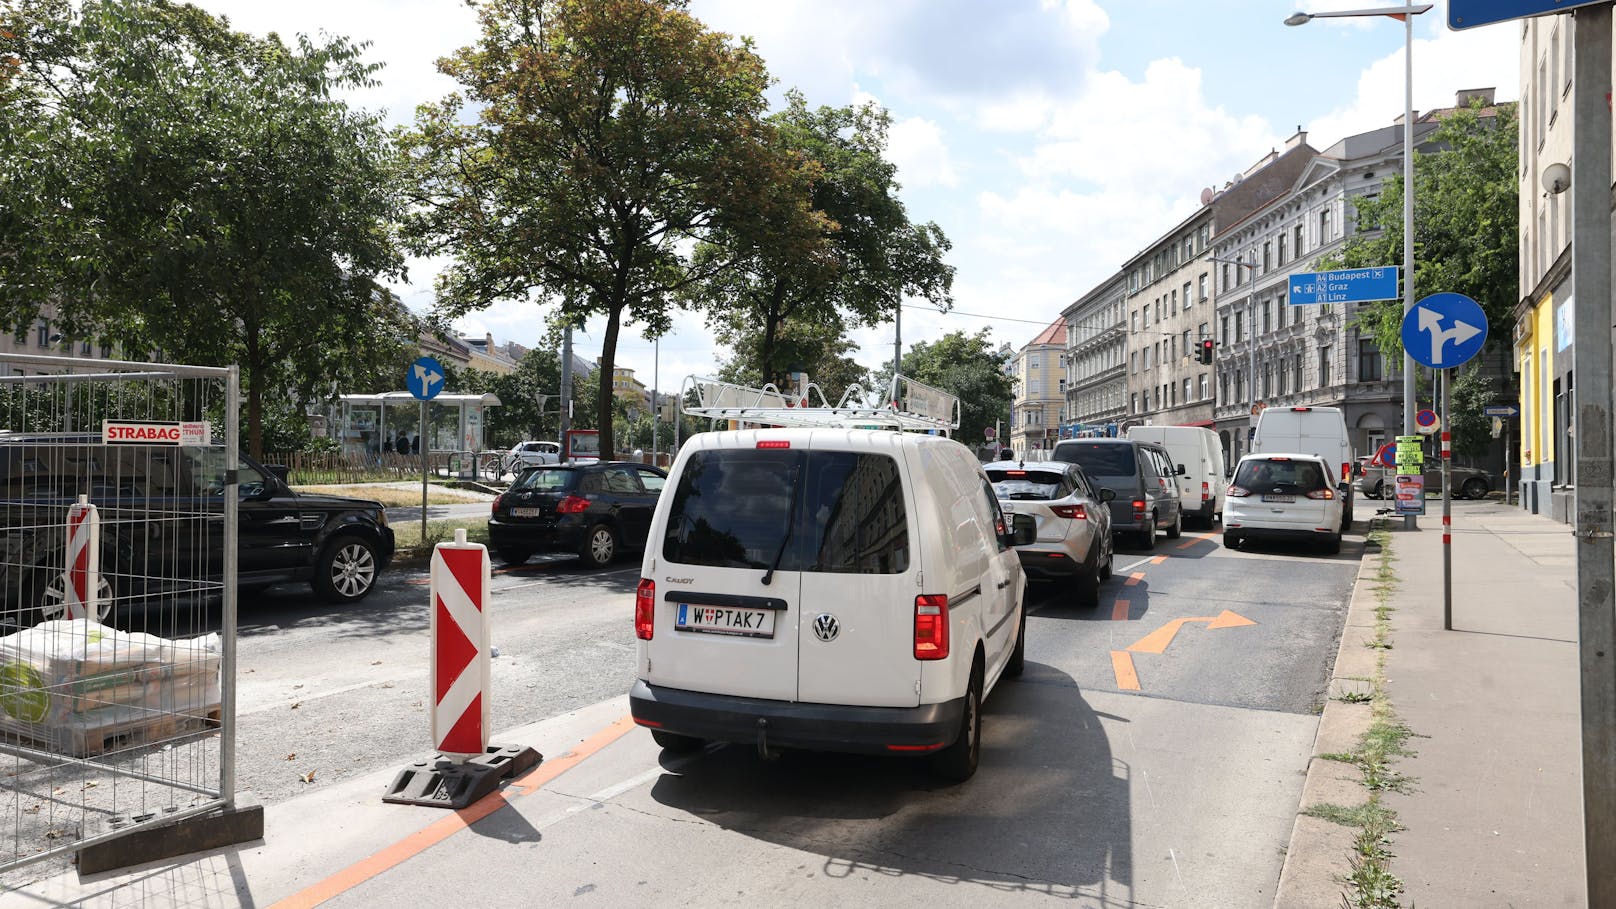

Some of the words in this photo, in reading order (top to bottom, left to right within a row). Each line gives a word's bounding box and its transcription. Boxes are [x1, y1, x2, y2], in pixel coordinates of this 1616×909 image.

[1317, 274, 1327, 282] A4
[1328, 271, 1370, 281] Budapest
[1317, 284, 1326, 292] A2
[1329, 283, 1348, 291] Graz
[1317, 294, 1326, 302] A1
[1328, 293, 1347, 301] Linz
[108, 427, 180, 440] STRABAG
[694, 608, 704, 624] W
